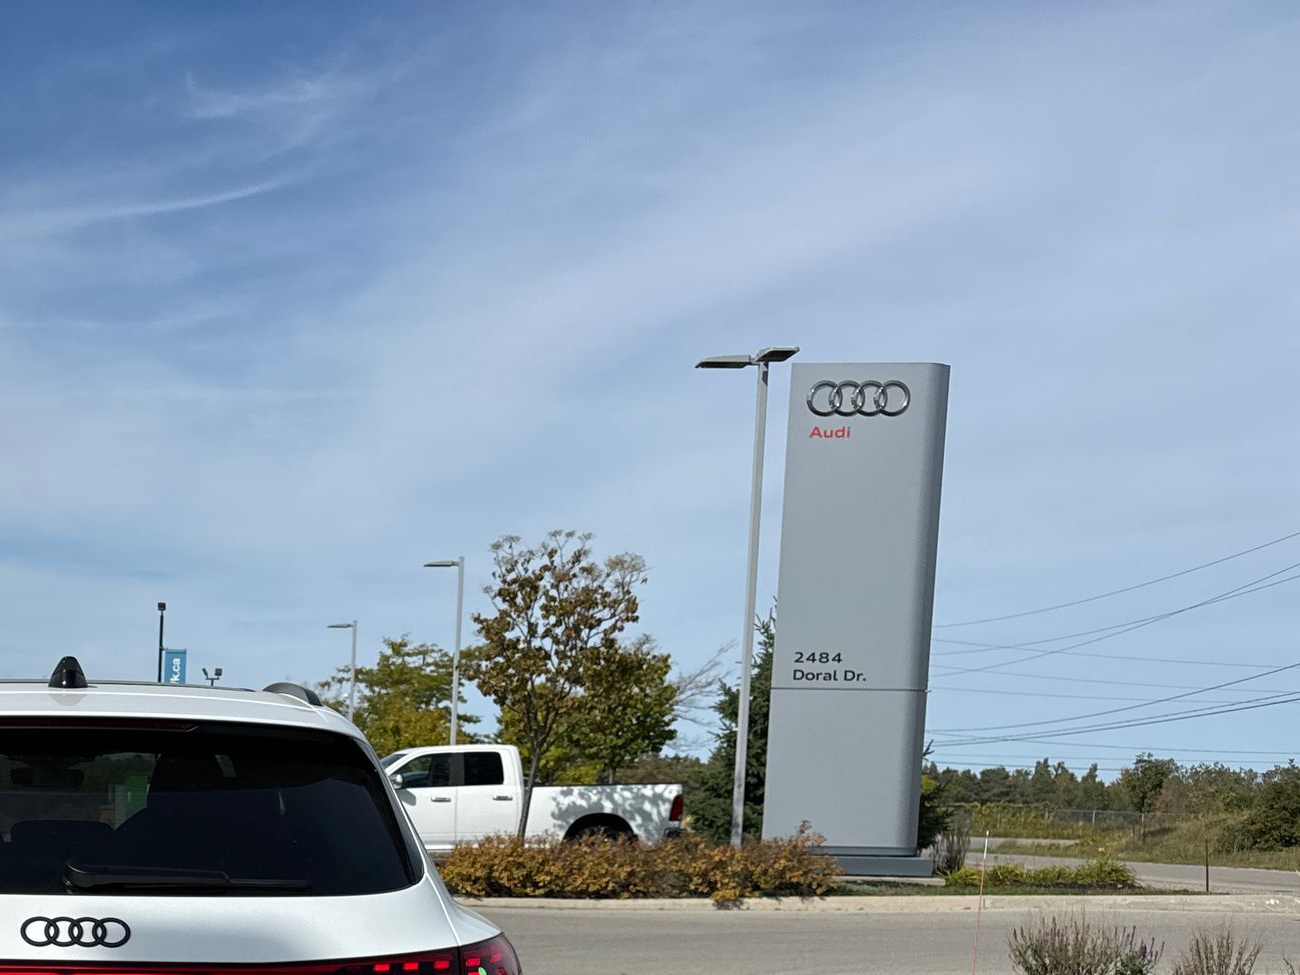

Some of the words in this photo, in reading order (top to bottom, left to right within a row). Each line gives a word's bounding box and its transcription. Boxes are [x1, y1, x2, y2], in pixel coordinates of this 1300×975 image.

[809, 426, 851, 438] Audi
[794, 651, 843, 664] 2484
[793, 669, 838, 681] Doral
[843, 669, 867, 682] Dr.
